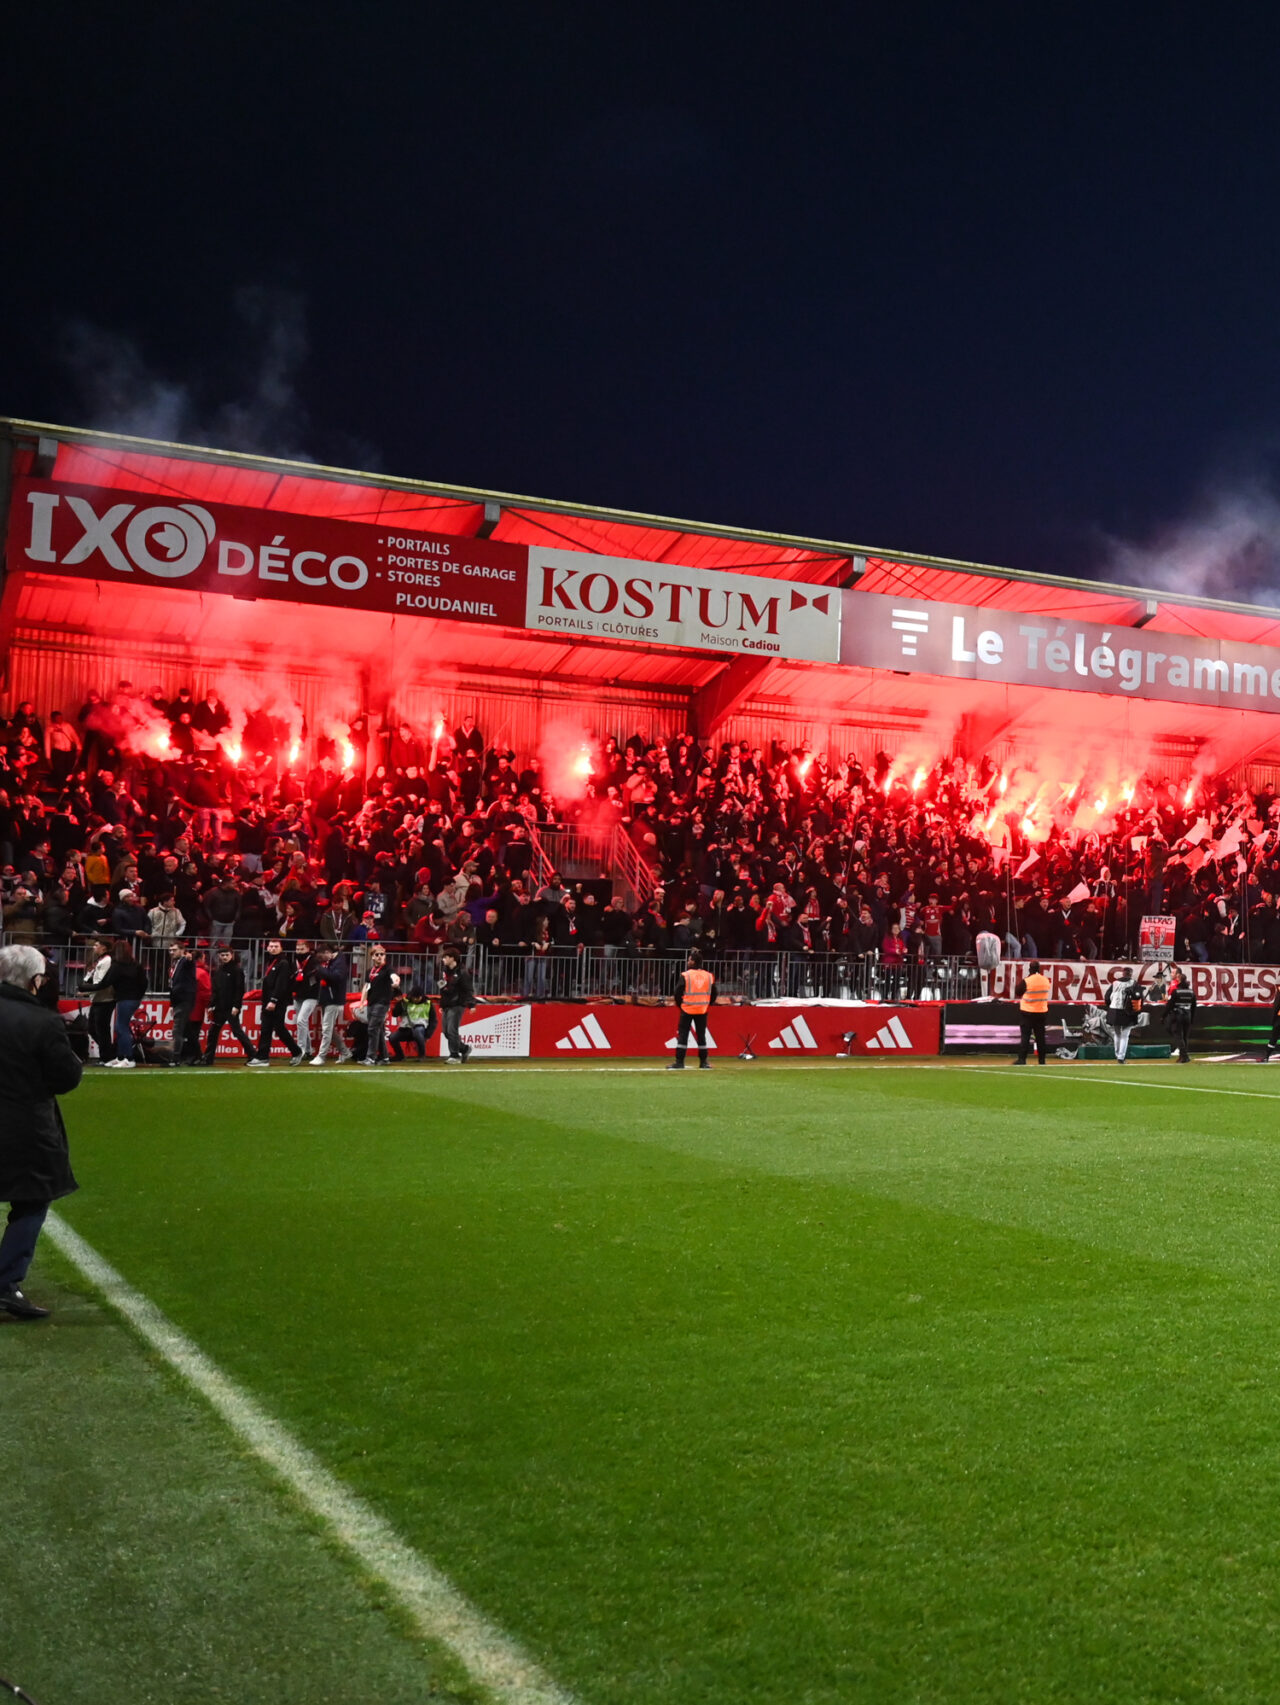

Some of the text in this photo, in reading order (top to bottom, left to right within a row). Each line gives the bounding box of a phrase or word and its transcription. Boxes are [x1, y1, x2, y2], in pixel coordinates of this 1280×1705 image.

[24, 491, 369, 591] IXO DÉCO
[387, 535, 450, 556] PORTAILS
[387, 554, 517, 582] PORTES DE GARAGE
[387, 570, 441, 587] STORES
[396, 592, 498, 617] PLOUDANIEL
[539, 565, 780, 636] KOSTUM
[537, 614, 660, 638] PORTAILS CLÔTURES
[700, 632, 781, 652] Maison Cadiou
[951, 615, 1005, 666] Le
[459, 1034, 502, 1044] HARVET
